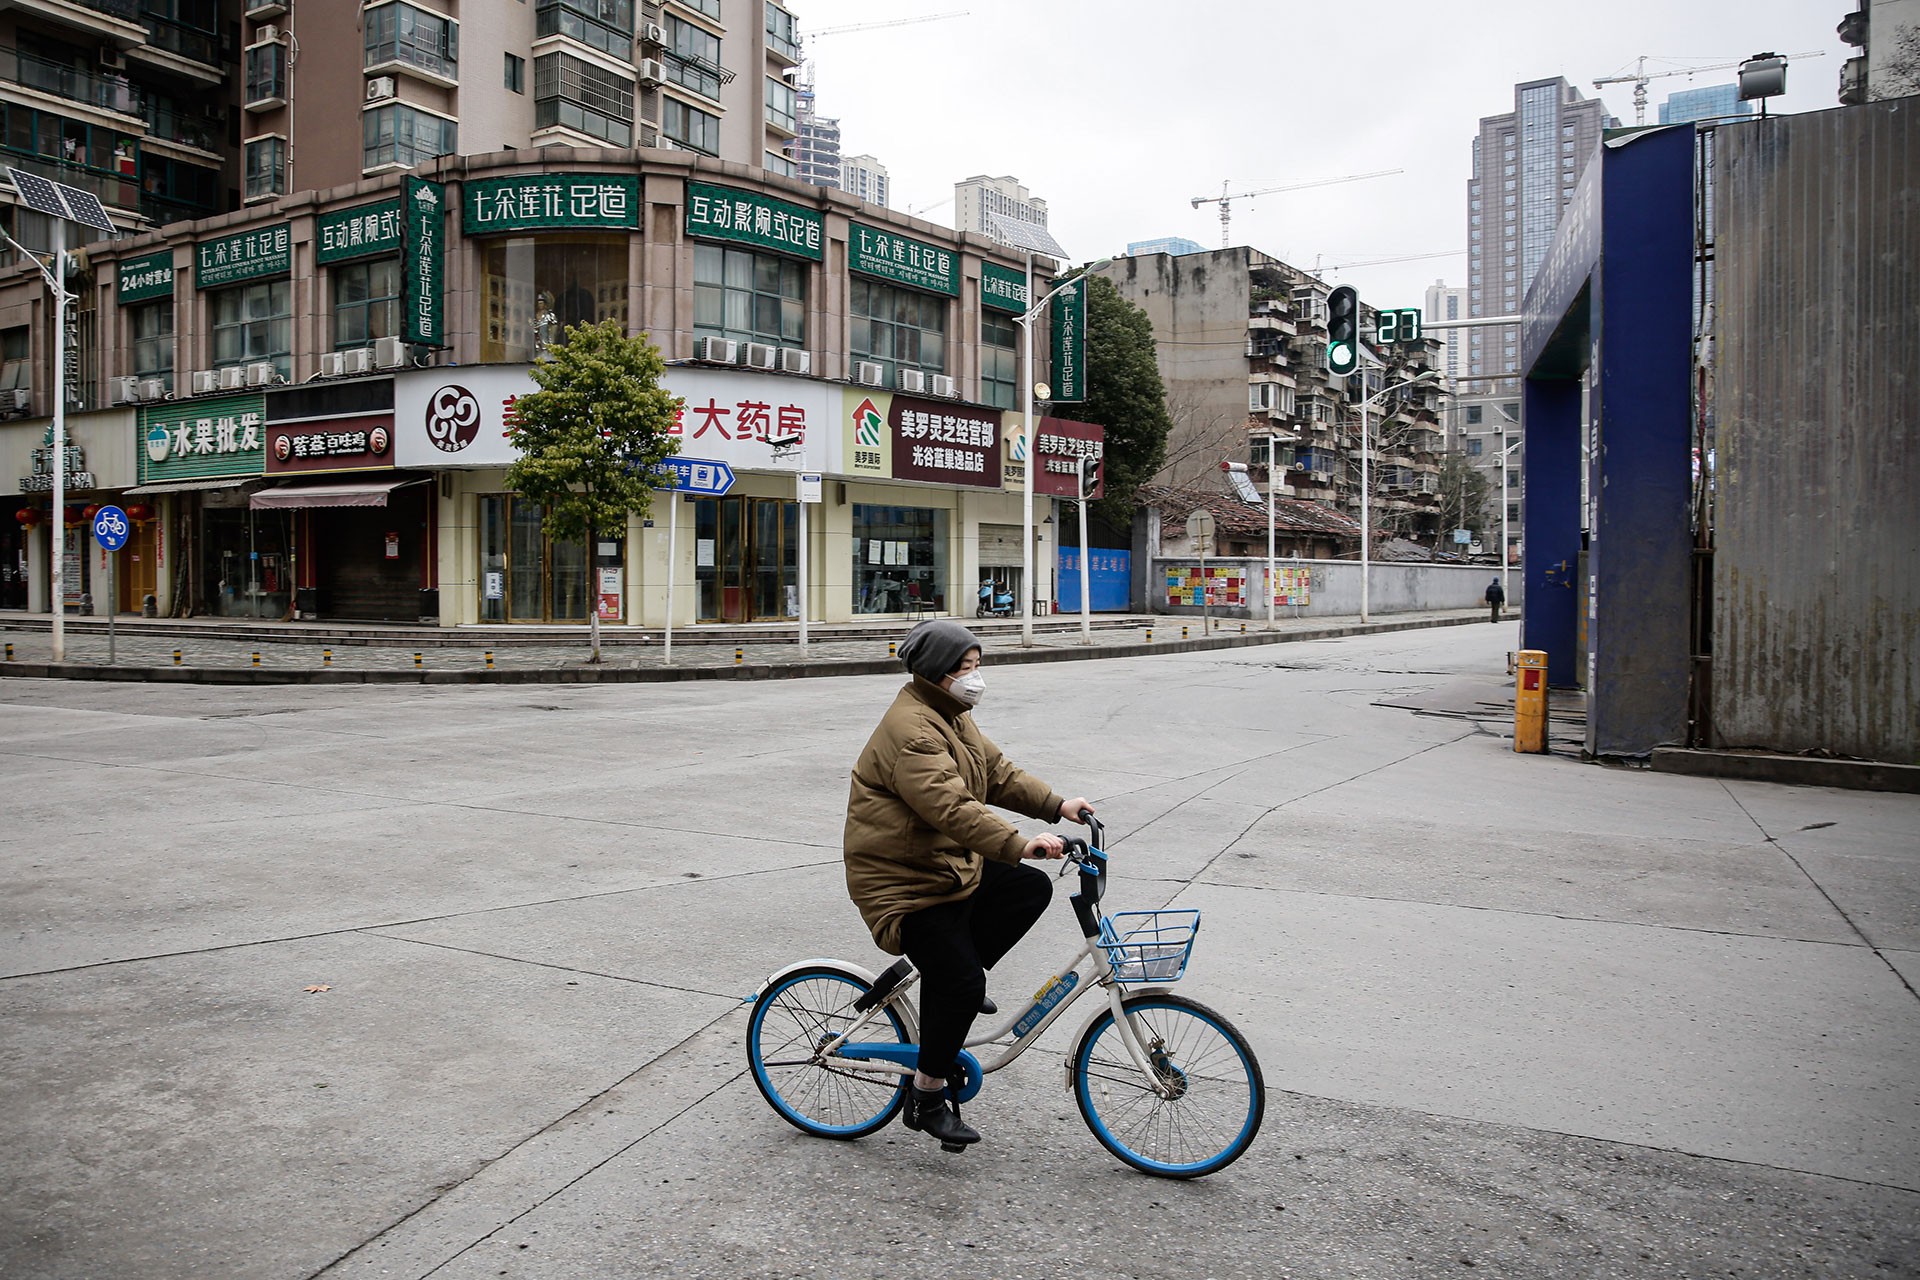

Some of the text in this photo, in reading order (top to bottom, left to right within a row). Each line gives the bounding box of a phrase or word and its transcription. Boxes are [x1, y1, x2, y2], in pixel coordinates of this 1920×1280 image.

[474, 185, 626, 222] 七朵莲花足道
[691, 196, 820, 250] 互动影院式足道
[200, 228, 288, 268] 七朵莲花足道
[859, 230, 950, 276] 七朵莲花足道
[859, 253, 949, 282] INTERACTIVE CINEMA FOOT MASSAGE
[121, 268, 172, 292] 24小时营业
[419, 215, 433, 337] 七朵莲花足道
[1378, 310, 1418, 343] 27
[1062, 306, 1074, 397] 七朵莲花足道
[173, 413, 262, 457] 水果批发
[901, 410, 994, 448] 美罗灵芝经营部
[913, 444, 985, 473] 光谷蓝巢逸品店
